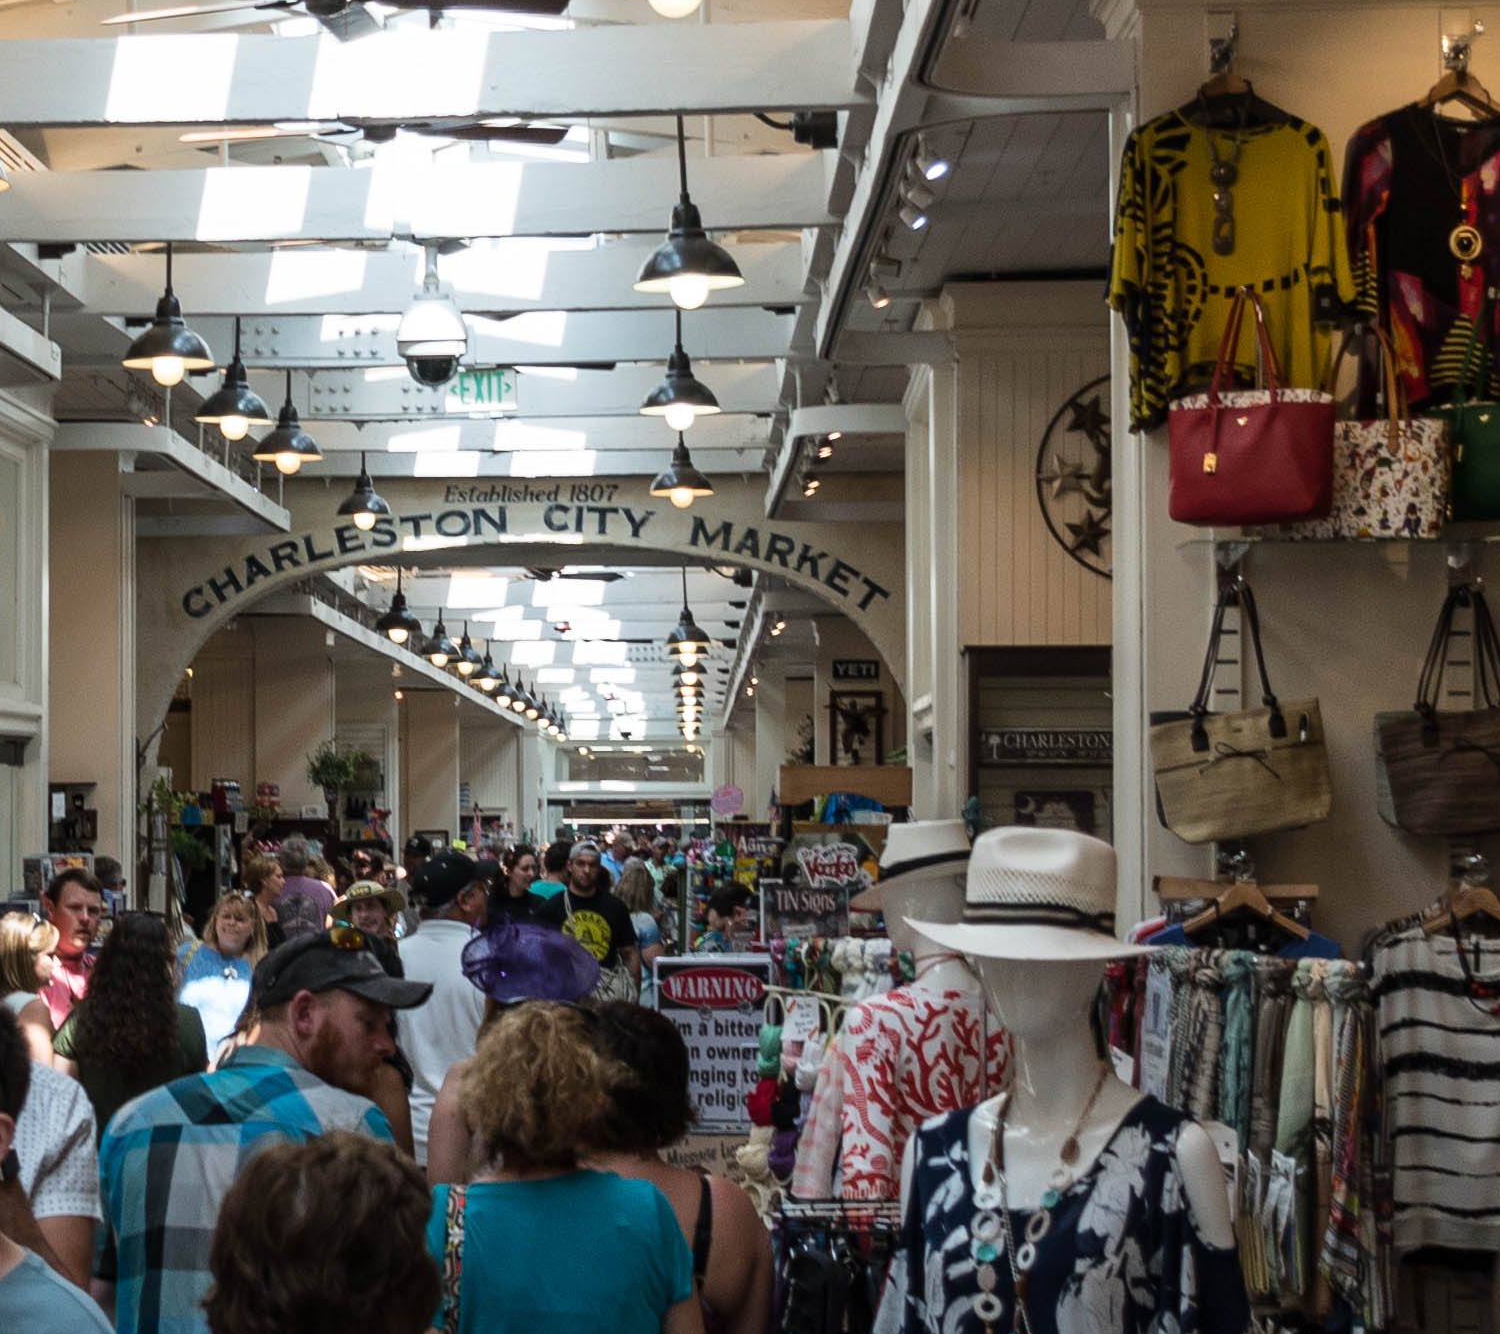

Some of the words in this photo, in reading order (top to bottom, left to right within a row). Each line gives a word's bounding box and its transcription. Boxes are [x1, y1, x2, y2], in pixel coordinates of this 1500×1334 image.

[459, 371, 505, 405] EXIT
[443, 483, 560, 504] Established
[569, 483, 619, 502] 1807
[181, 505, 509, 619] CHARLESTON
[543, 503, 656, 539] CITY
[689, 515, 892, 612] MARKET
[835, 662, 876, 676] YETI
[1003, 732, 1112, 749] CHARLESTON
[776, 890, 799, 912] TIN
[801, 889, 836, 915] Signs
[668, 976, 761, 1001] WARNING
[698, 1022, 709, 1037] a
[714, 1018, 761, 1037] bitter
[706, 1045, 759, 1060] owner
[690, 1066, 737, 1086] nging
[742, 1067, 760, 1084] to
